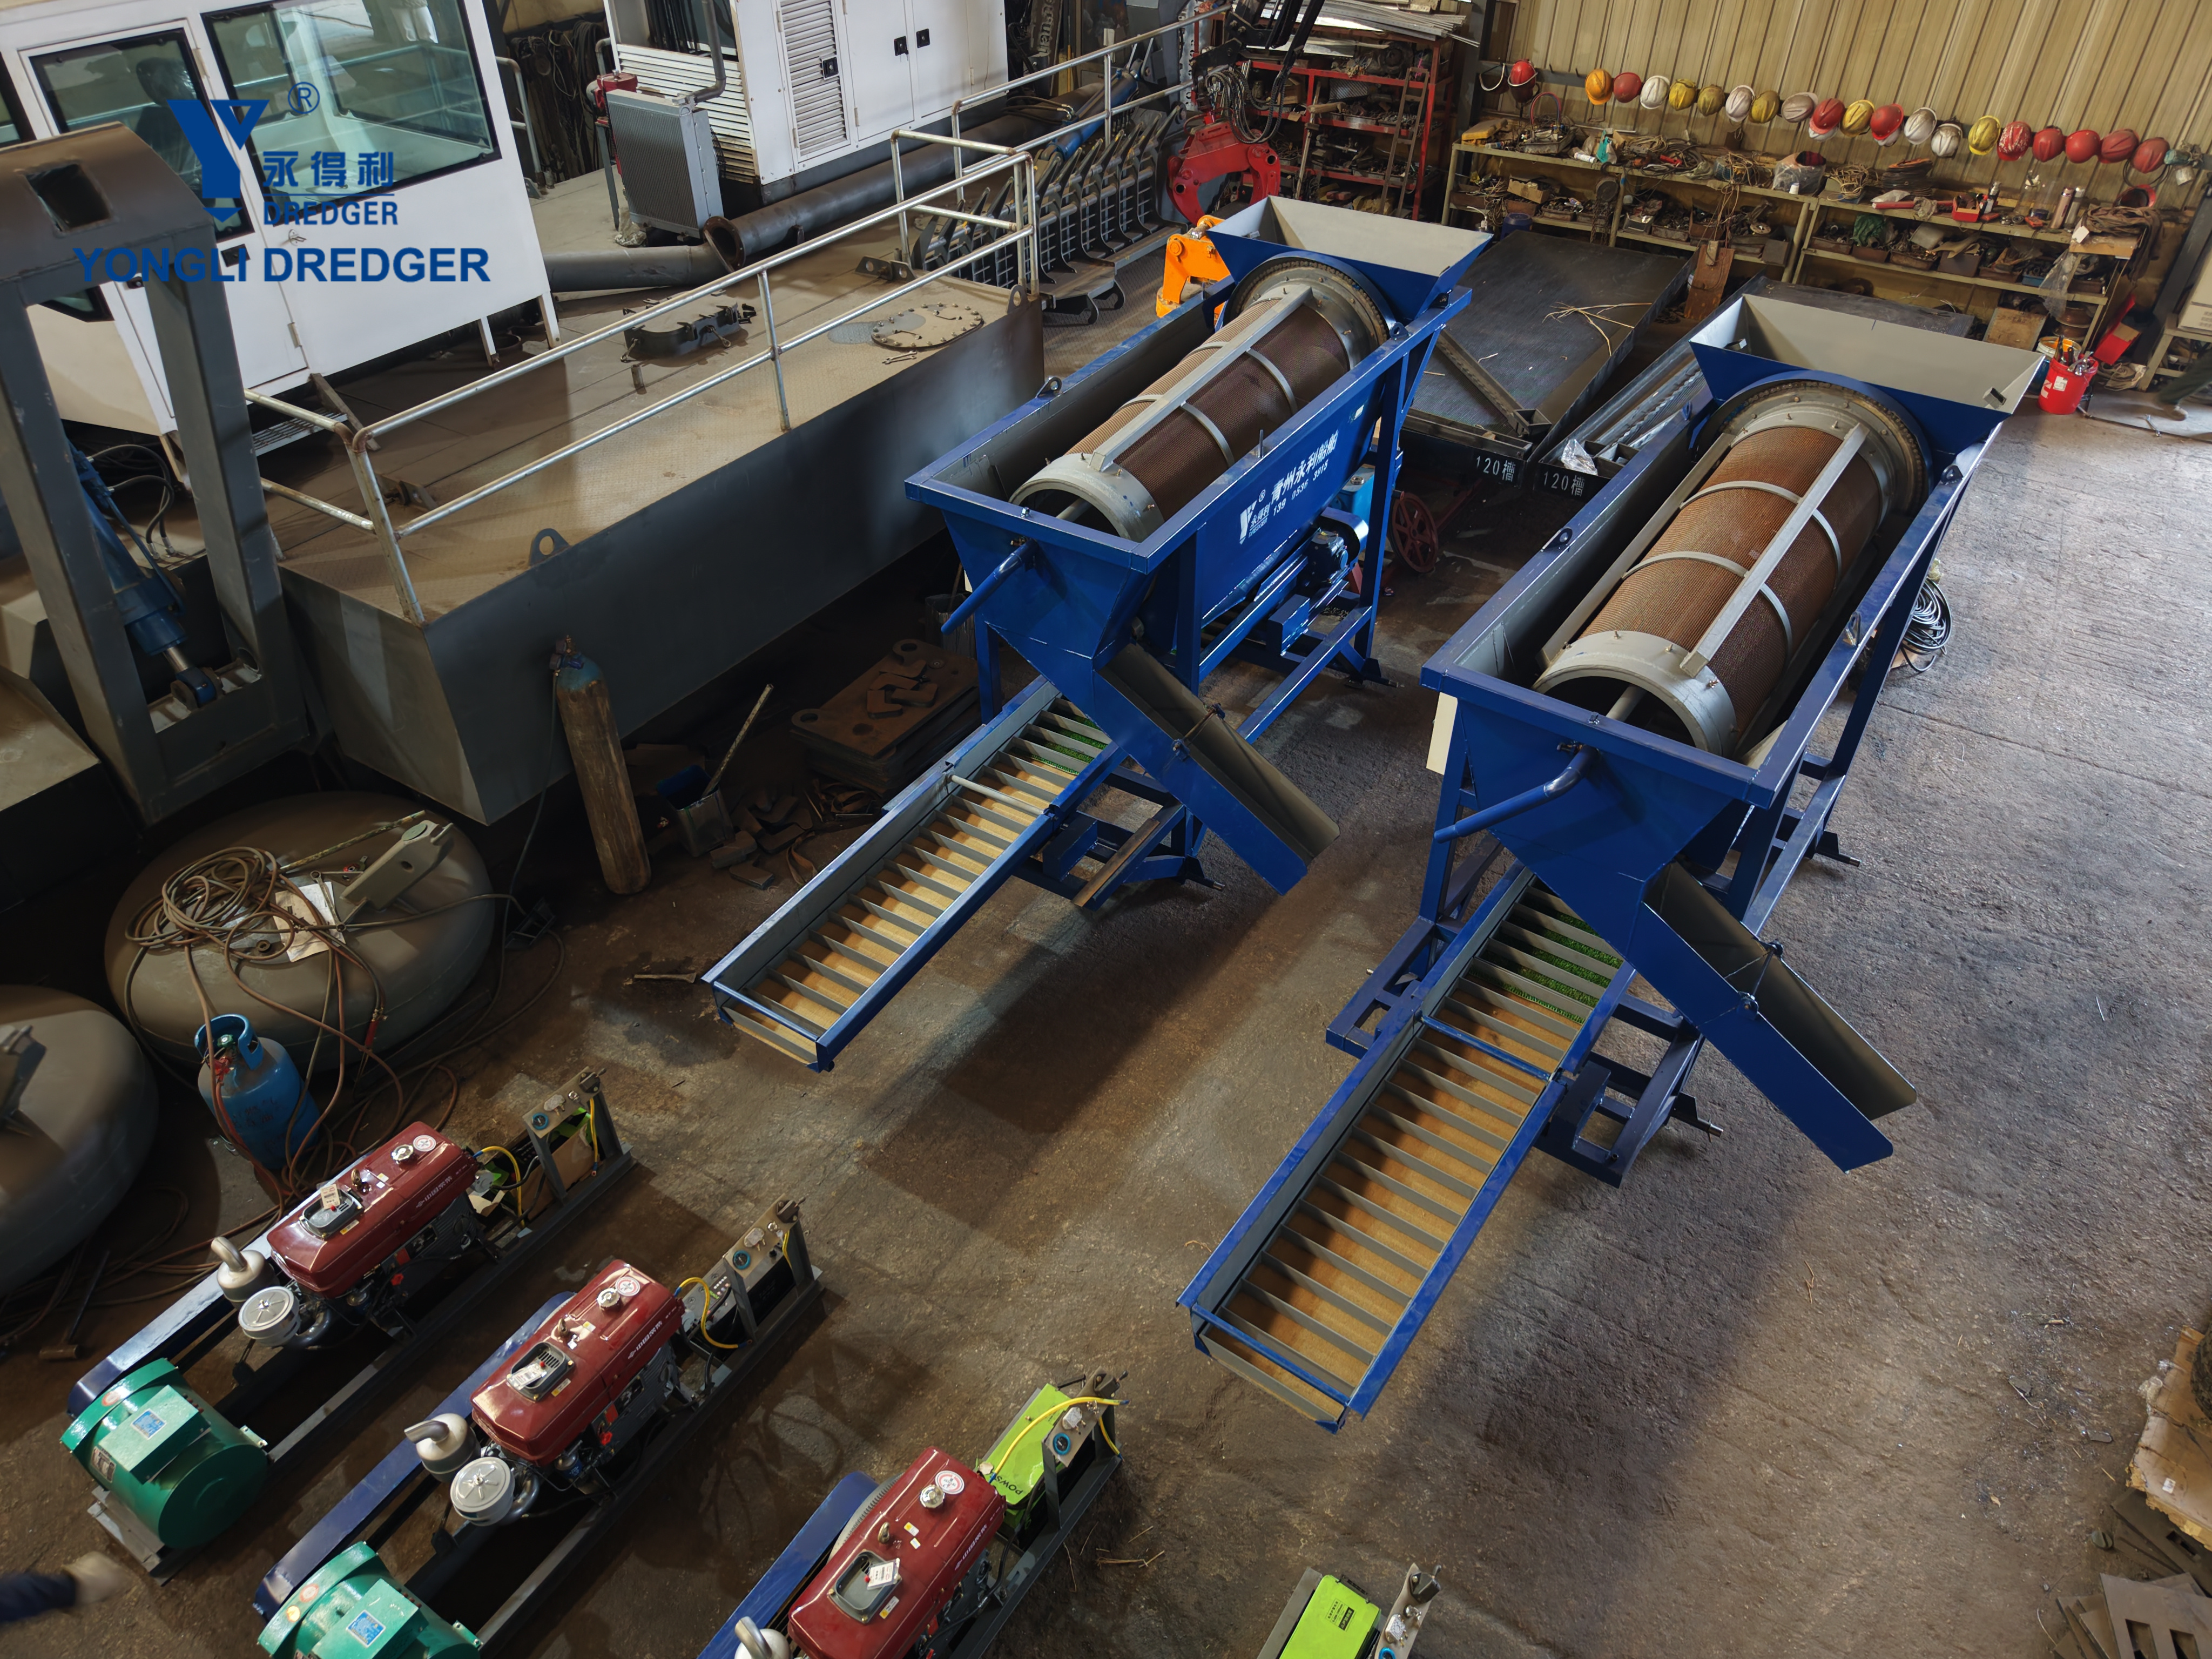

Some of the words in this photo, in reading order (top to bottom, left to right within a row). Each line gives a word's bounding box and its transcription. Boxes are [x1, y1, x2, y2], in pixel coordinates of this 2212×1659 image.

[1271, 429, 1339, 505] 青州永利船舶
[1273, 497, 1286, 516] 139
[1291, 478, 1309, 501] 0536
[1313, 458, 1329, 481] 3915
[994, 1475, 1024, 1495] POWS
